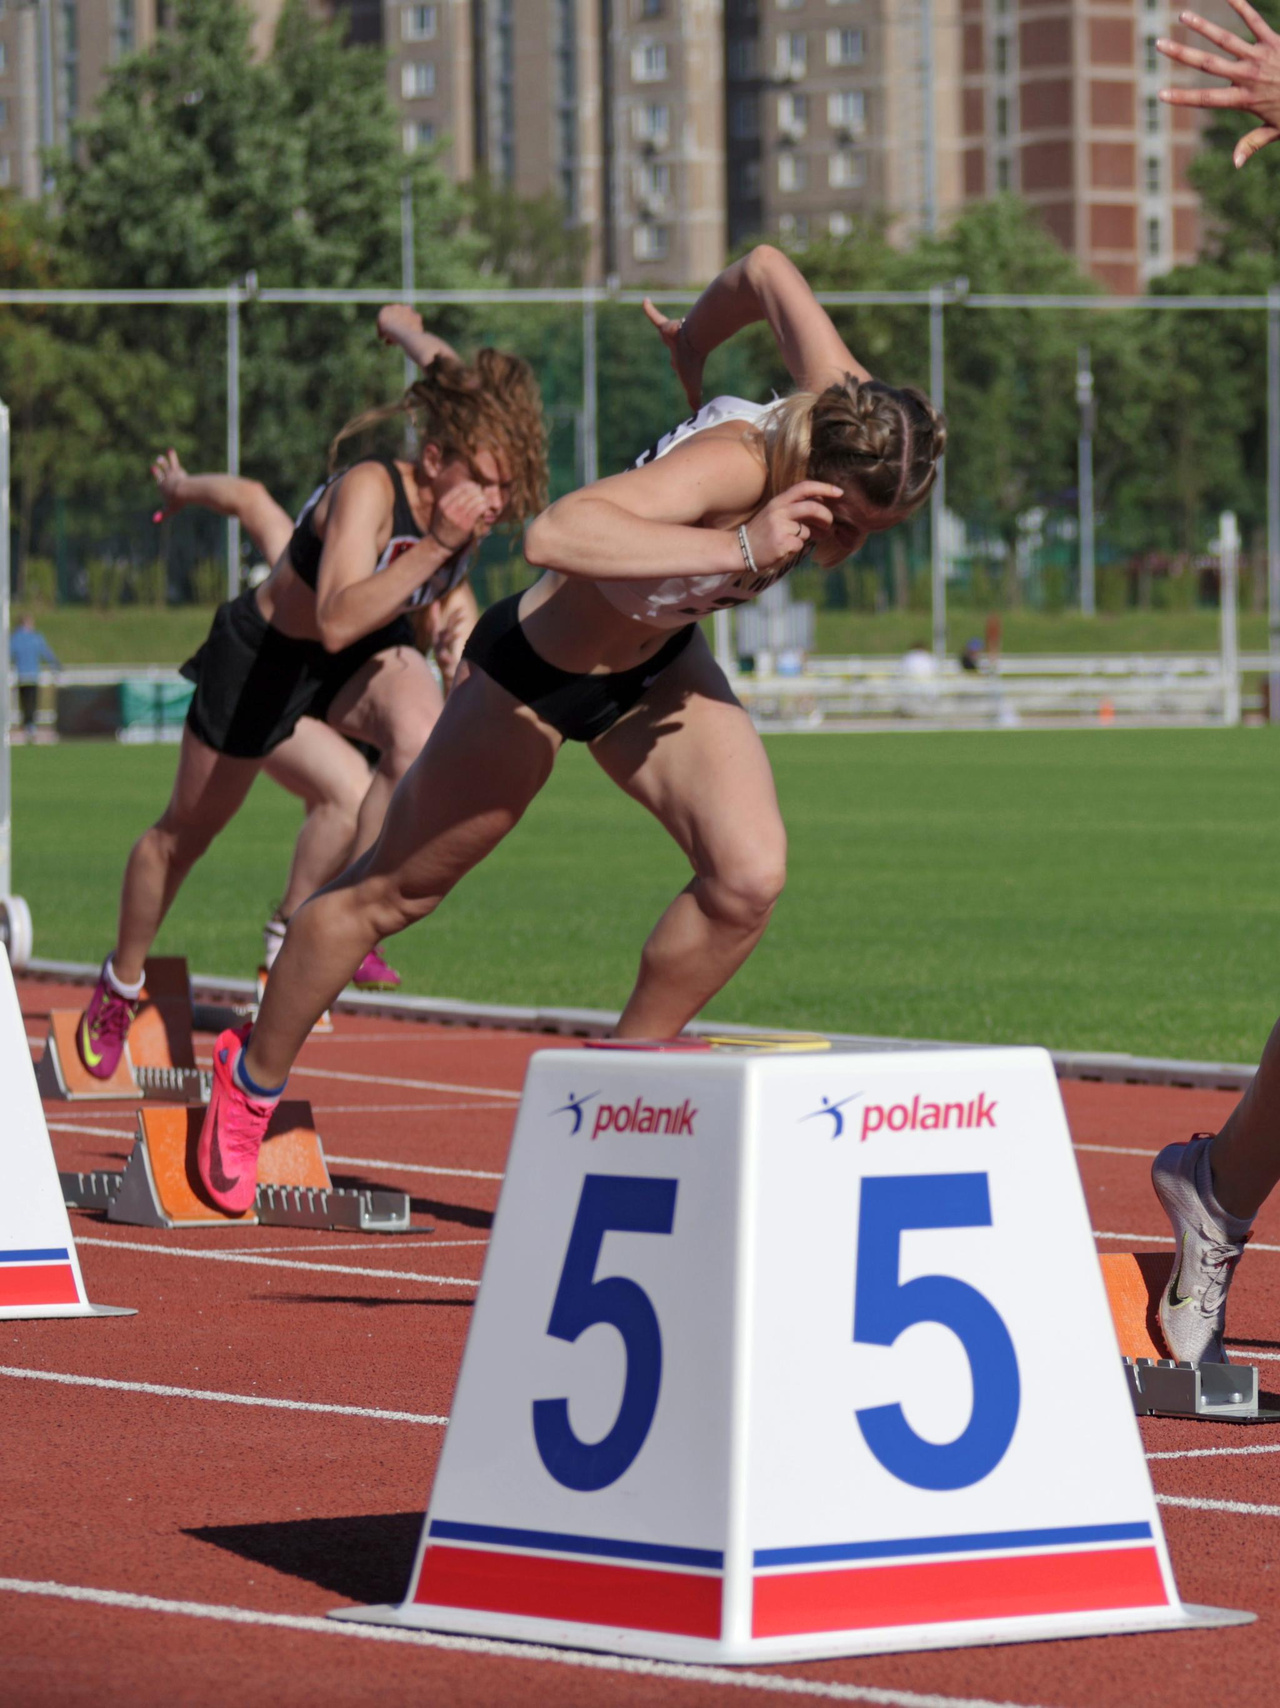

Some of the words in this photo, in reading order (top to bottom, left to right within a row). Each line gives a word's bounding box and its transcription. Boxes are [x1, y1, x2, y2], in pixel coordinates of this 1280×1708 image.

[592, 1097, 697, 1140] polanik
[861, 1092, 998, 1142] polanik
[532, 1173, 679, 1492] 5
[853, 1171, 1021, 1491] 5
